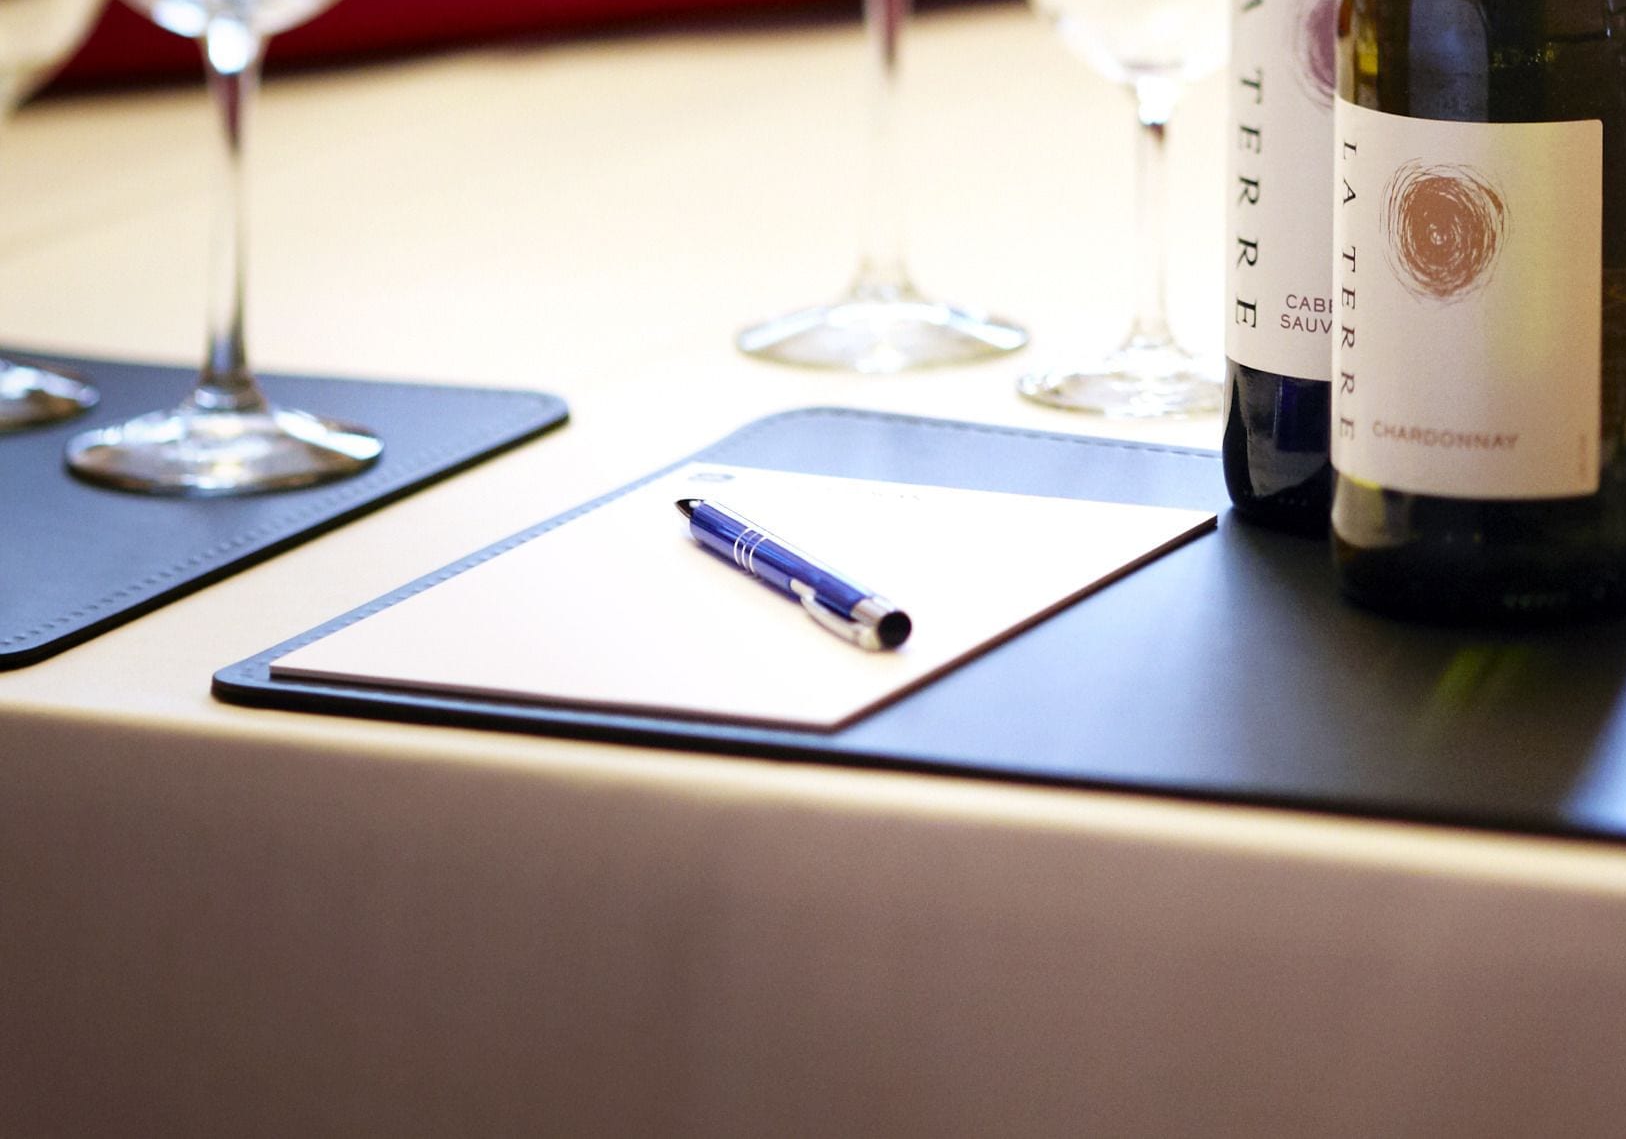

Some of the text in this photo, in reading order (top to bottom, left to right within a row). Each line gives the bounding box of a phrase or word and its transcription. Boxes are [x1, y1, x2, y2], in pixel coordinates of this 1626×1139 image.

[1234, 68, 1263, 329] TERRE
[1339, 140, 1357, 440] LA TERRE
[1372, 420, 1519, 449] CHARDONNAY
